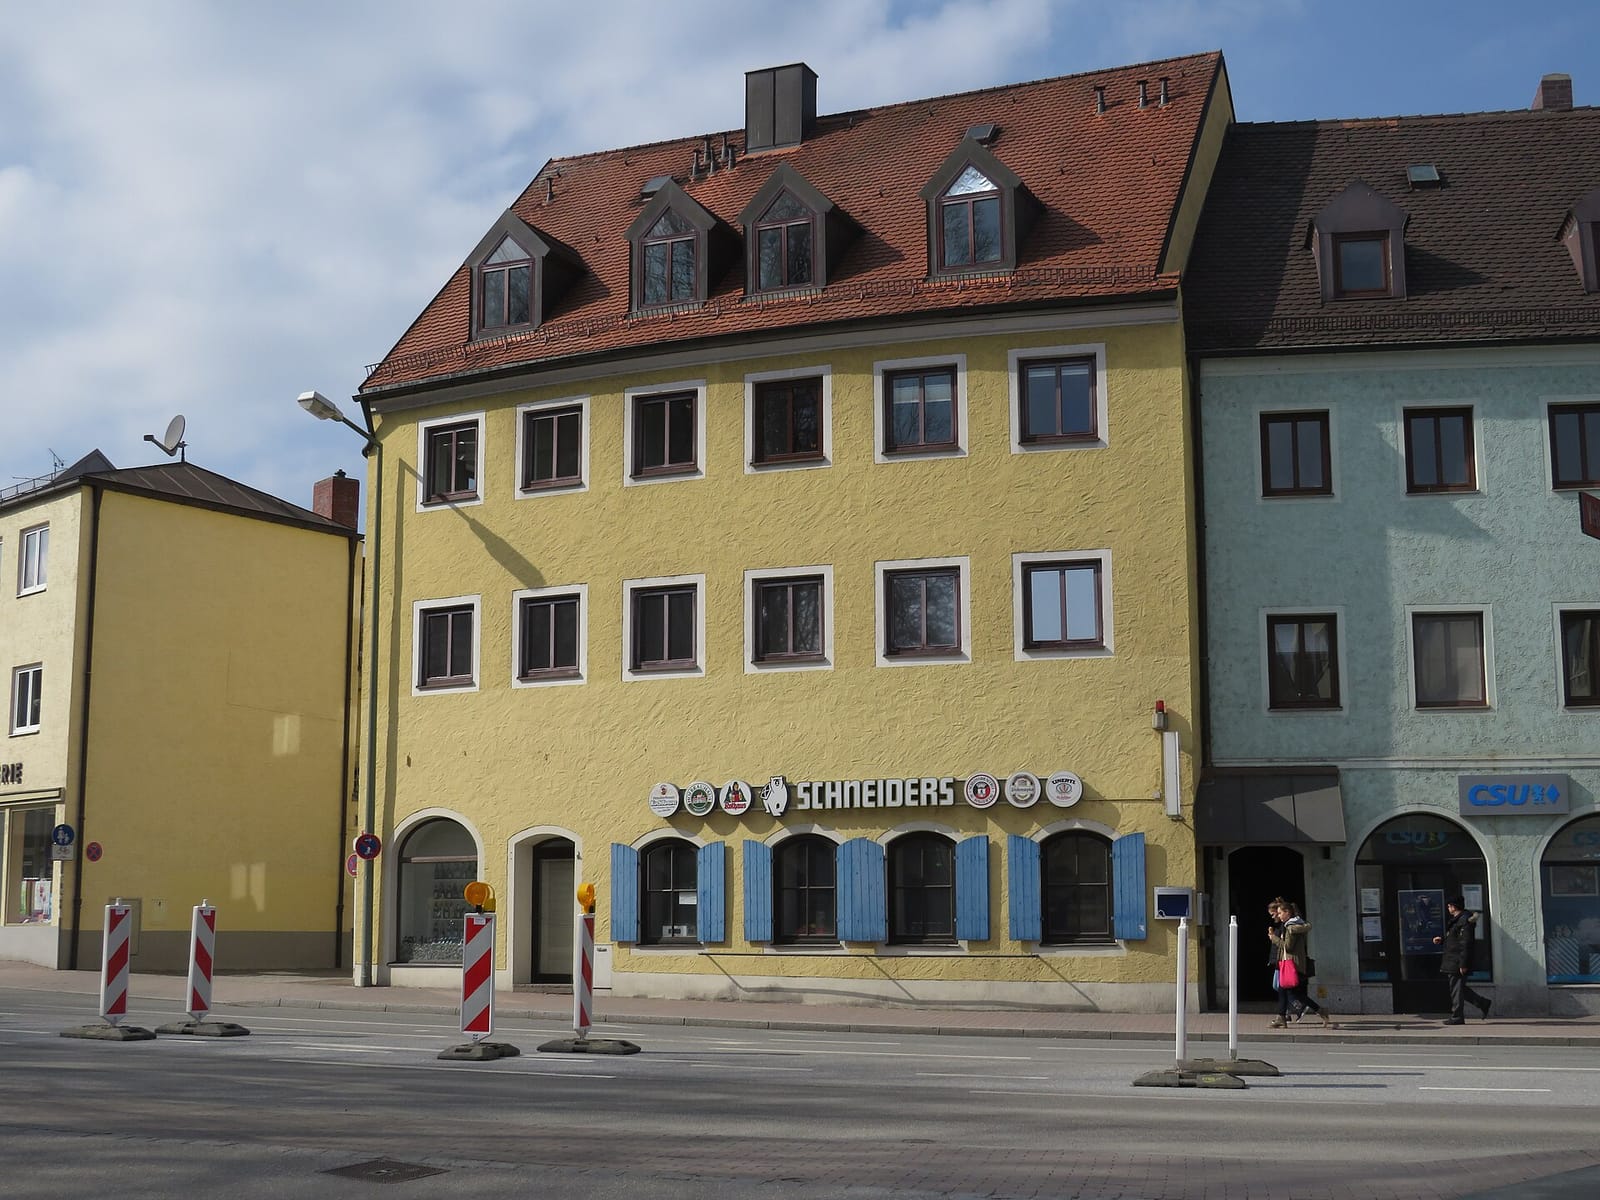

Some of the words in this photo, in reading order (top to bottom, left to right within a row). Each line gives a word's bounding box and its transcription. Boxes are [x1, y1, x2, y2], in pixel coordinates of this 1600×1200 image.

[0, 763, 23, 786] RIE
[796, 777, 955, 810] SCHNEIDERS
[1468, 783, 1530, 807] CSU
